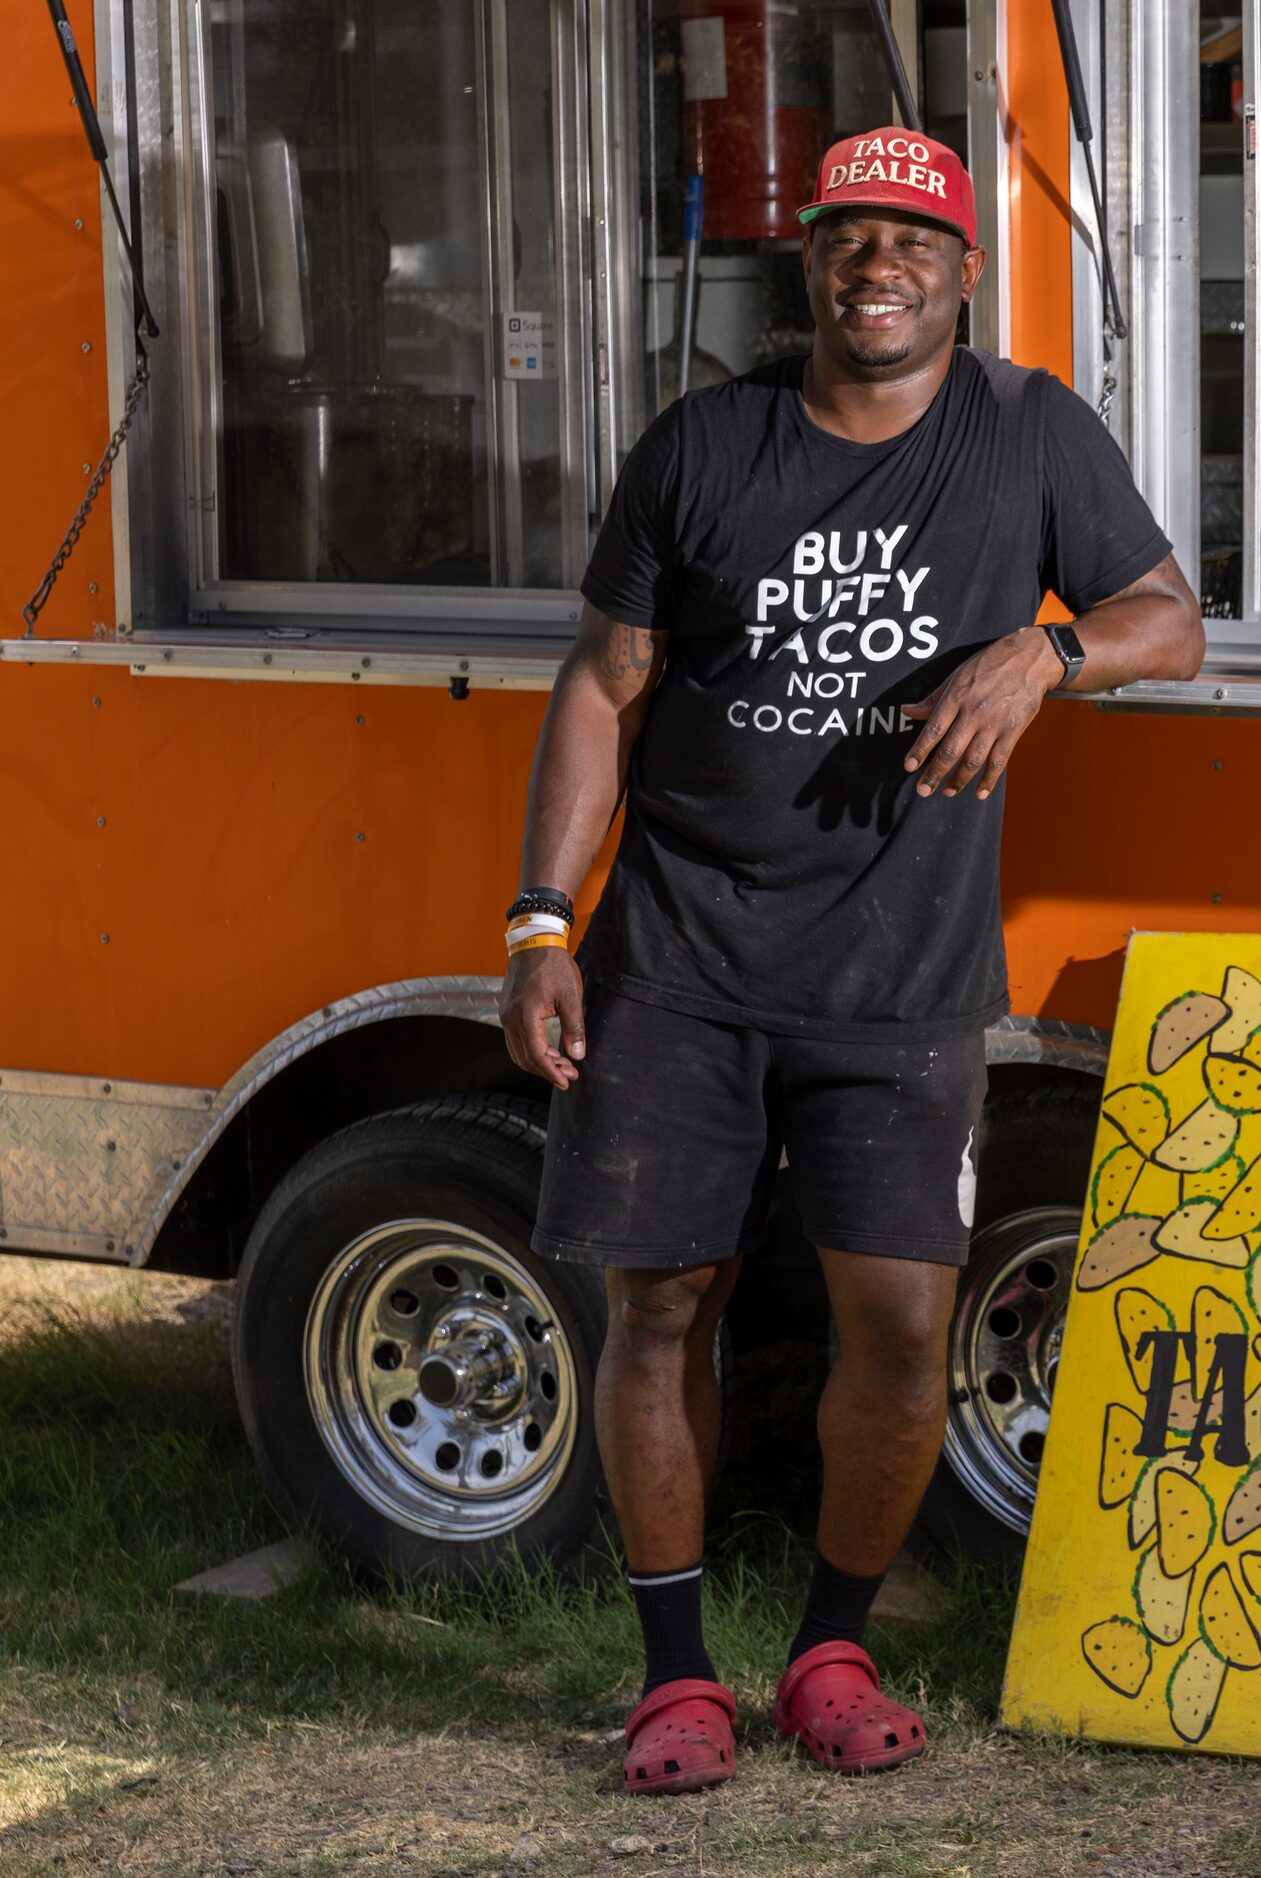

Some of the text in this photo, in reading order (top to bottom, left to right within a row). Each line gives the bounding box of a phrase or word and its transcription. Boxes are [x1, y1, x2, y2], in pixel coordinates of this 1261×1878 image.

[853, 136, 930, 163] TACO
[826, 159, 947, 199] DEALER
[793, 525, 909, 575] BUY
[757, 567, 931, 623] PUFFY
[745, 615, 939, 664] TACOS
[786, 670, 867, 699] NOT
